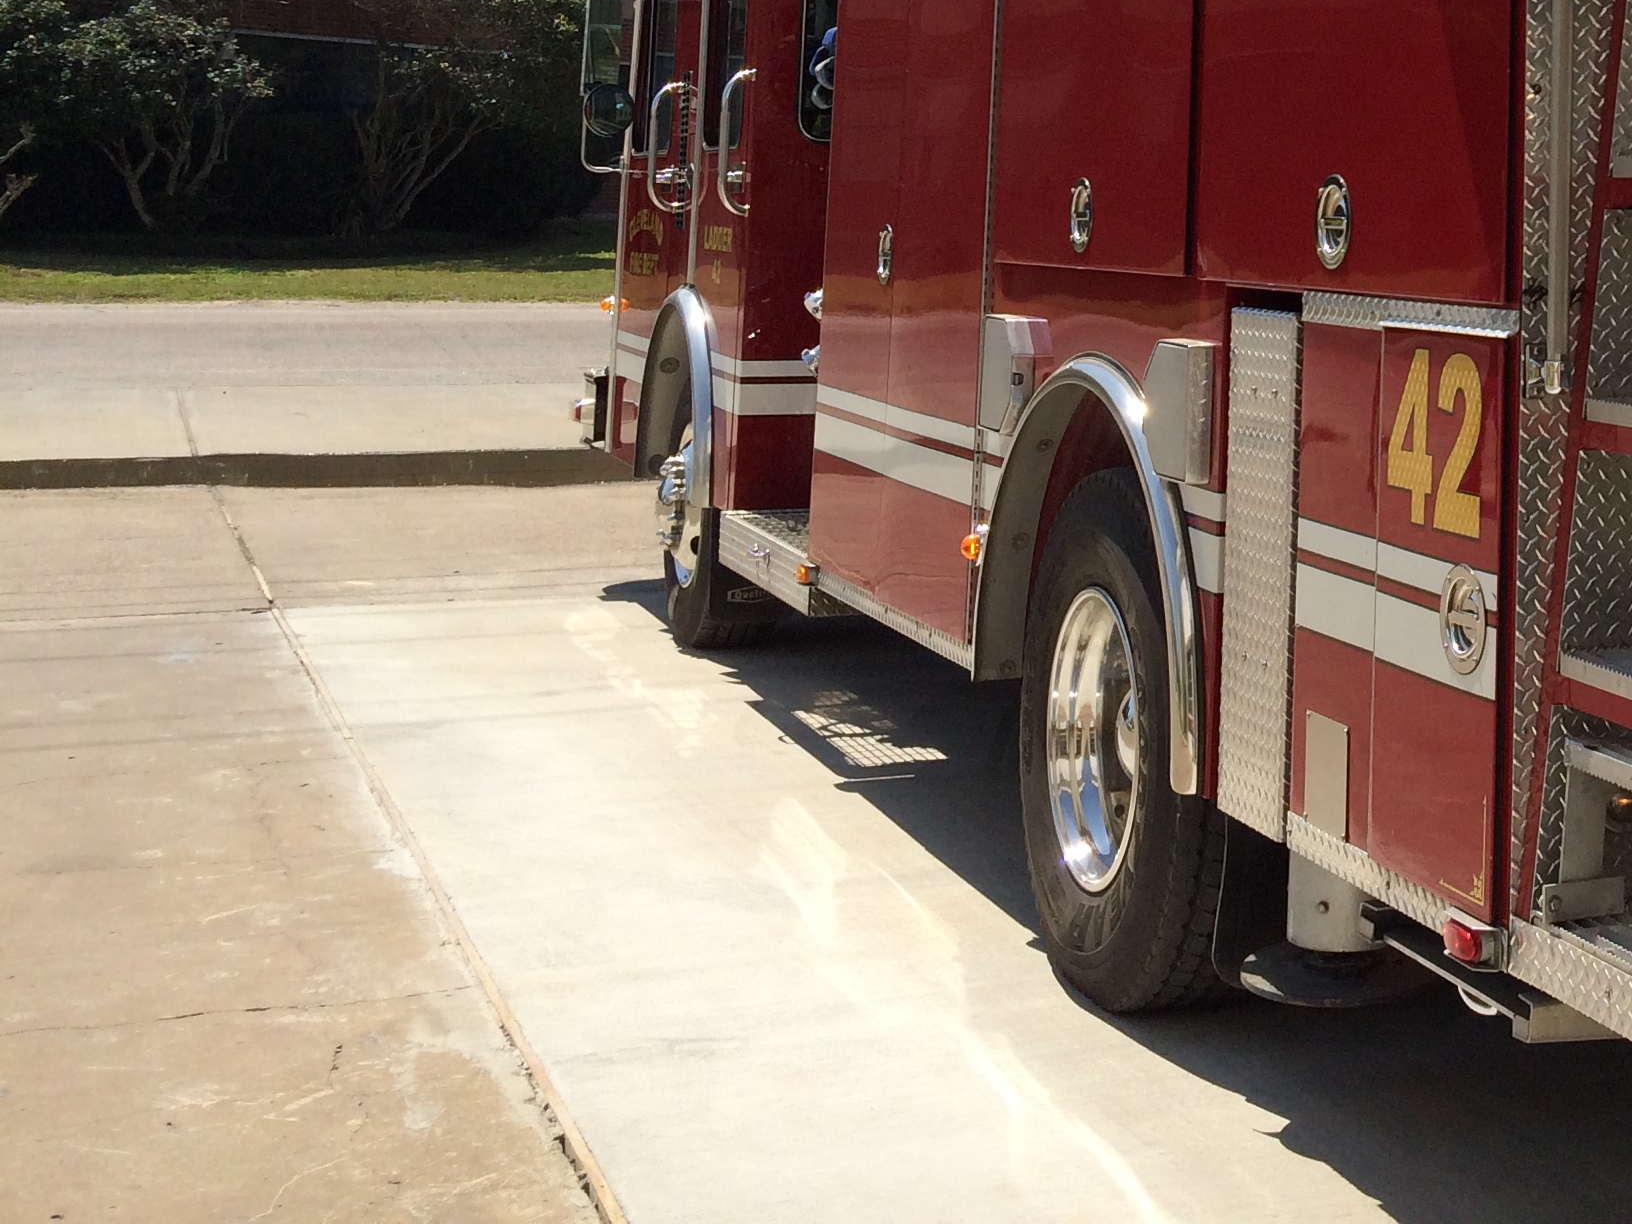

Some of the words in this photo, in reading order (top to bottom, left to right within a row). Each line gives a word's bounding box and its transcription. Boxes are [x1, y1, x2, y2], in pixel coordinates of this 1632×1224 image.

[703, 225, 733, 253] LADDER
[1387, 348, 1483, 540] 42
[734, 588, 769, 600] Qualit
